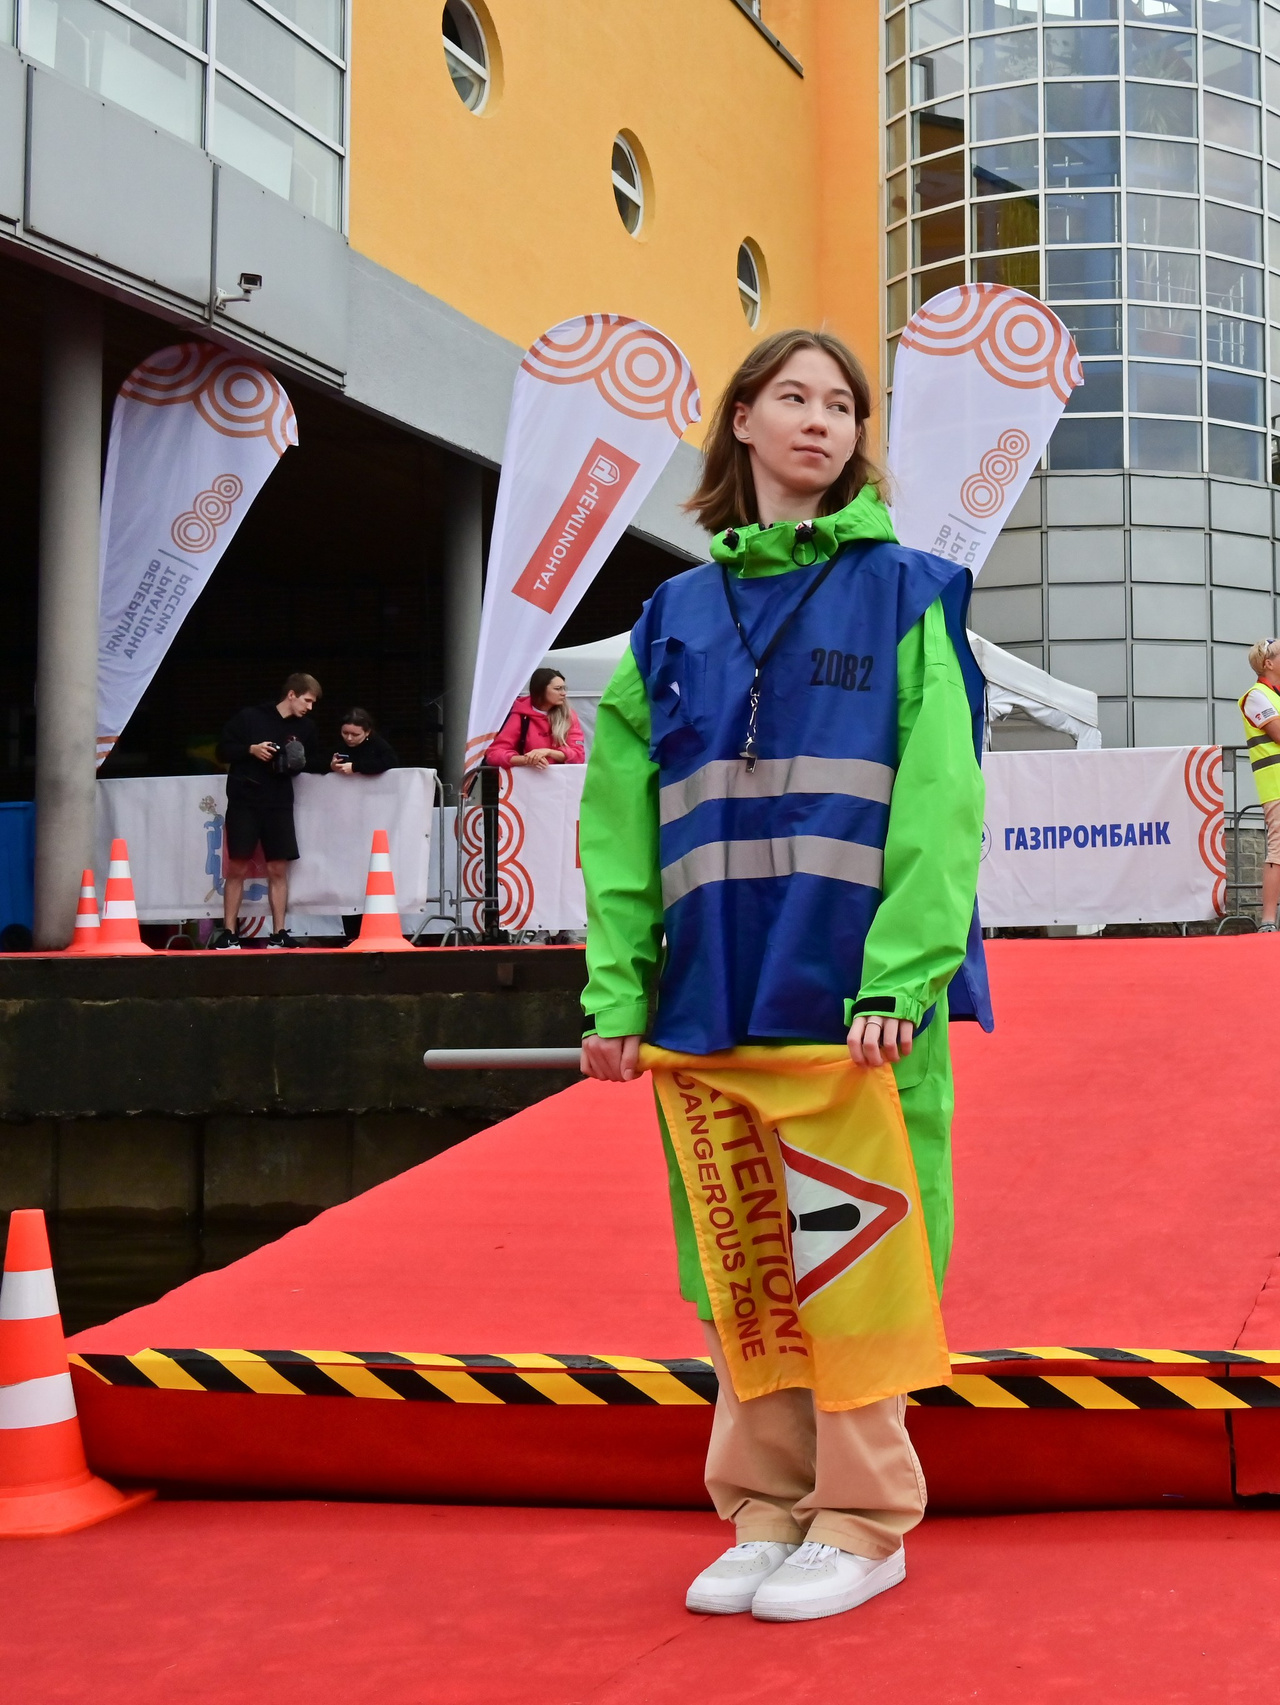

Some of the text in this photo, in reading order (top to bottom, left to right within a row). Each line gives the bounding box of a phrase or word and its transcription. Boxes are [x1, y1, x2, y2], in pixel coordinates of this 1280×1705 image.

[809, 647, 874, 692] 2082
[1004, 821, 1171, 851] ГАЗПРОМБАНК
[709, 1088, 809, 1358] TTENTION!
[729, 1276, 766, 1362] ZONE
